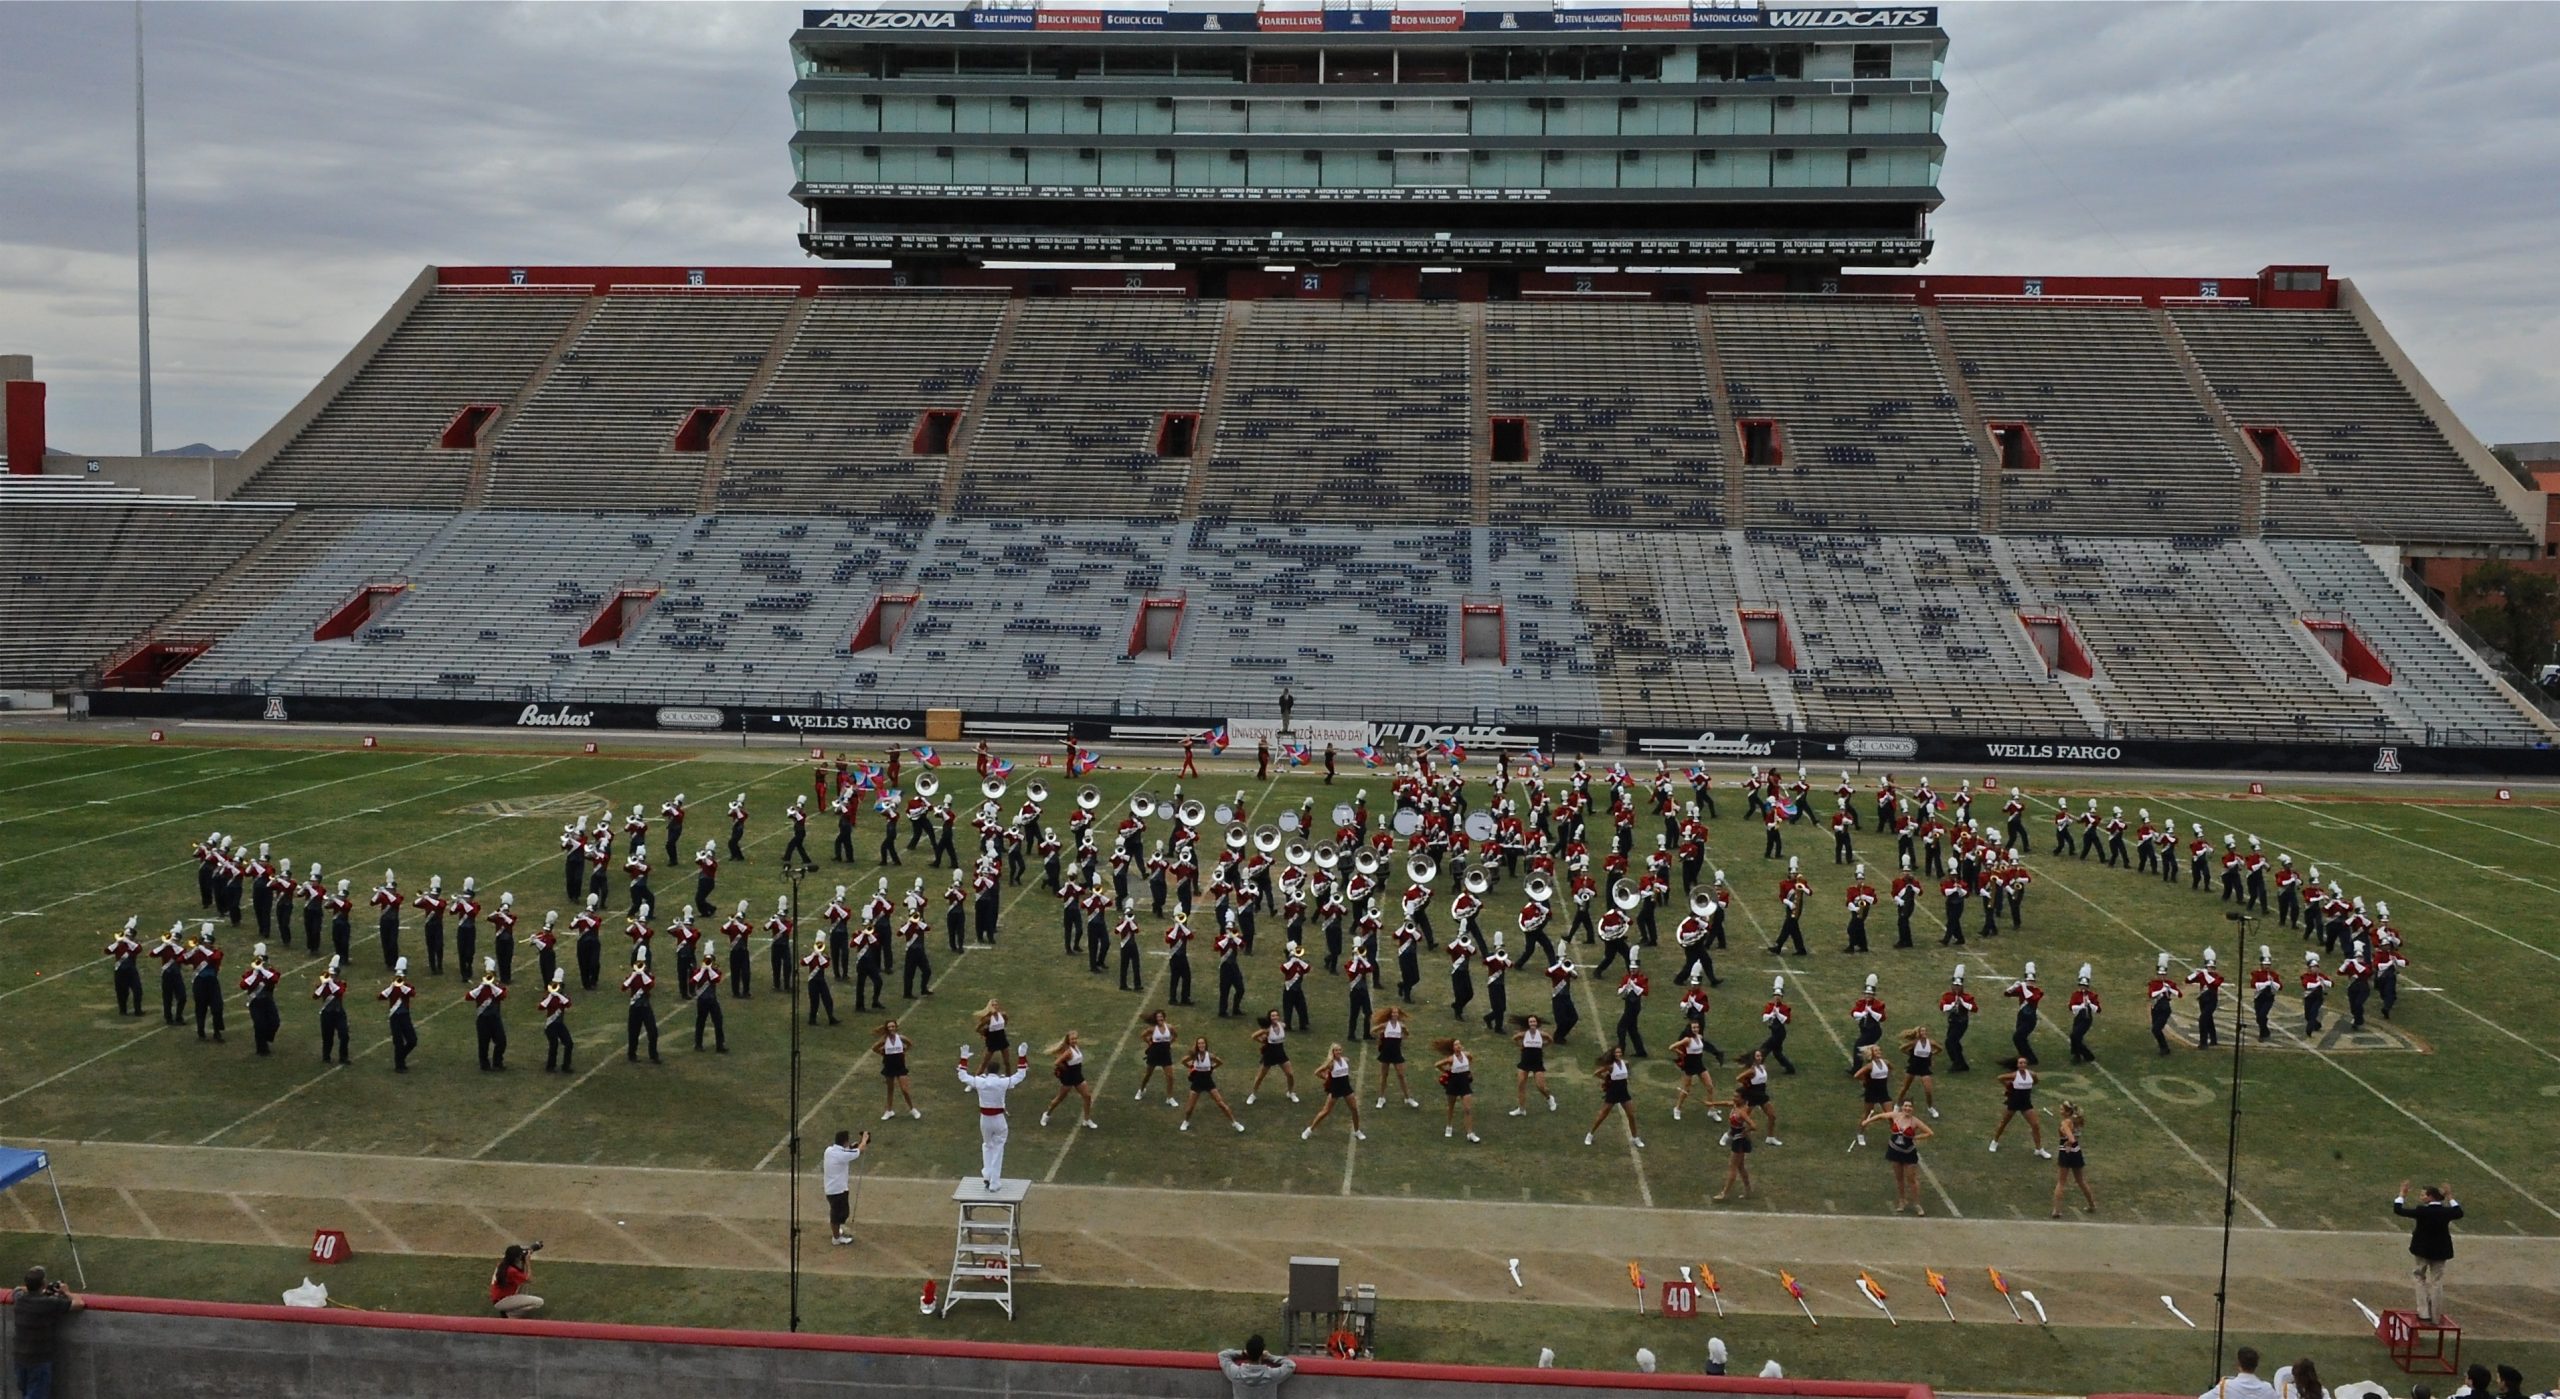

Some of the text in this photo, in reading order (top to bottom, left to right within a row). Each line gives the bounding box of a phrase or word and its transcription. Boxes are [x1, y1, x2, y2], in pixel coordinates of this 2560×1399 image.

[819, 13, 955, 28] ARIZONA
[974, 13, 1032, 23] 22 ART LUPPINO
[1038, 14, 1101, 24] 89 RICKY HUNLEY
[1107, 15, 1163, 24] 6 CHUCK CECIL
[1204, 14, 1221, 30] A
[1258, 16, 1322, 25] 4 DARRYLL LEWIS
[1401, 16, 1418, 24] ROB
[1419, 16, 1456, 24] WALDROP
[1500, 13, 1518, 29] A
[1554, 14, 1622, 23] 28 STEVE McLAUGHLIN
[1630, 14, 1652, 22] CHRIS
[1653, 13, 1690, 22] McALISTER
[1693, 12, 1758, 22] 5 ANTOINE CASON
[1769, 10, 1929, 26] WILDCATS
[512, 275, 524, 284] 17
[689, 275, 703, 285] 18
[894, 276, 906, 286] 19
[1126, 277, 1142, 288] 20
[1305, 279, 1318, 289] 21
[1576, 281, 1592, 292] 22
[1822, 283, 1837, 293] 23
[2025, 286, 2041, 296] 24
[2201, 287, 2217, 297] 25
[88, 461, 100, 471] 16
[264, 697, 287, 720] A
[517, 704, 594, 726] Bashas'
[681, 712, 717, 721] CASINOS
[787, 715, 911, 729] WELLS FARGO
[1231, 728, 1272, 739] UNIVERSITY
[1324, 729, 1345, 741] BAND
[1348, 730, 1364, 742] DAY
[1871, 742, 1911, 751] CASINOS
[1987, 744, 2121, 759] WELLS FARGO
[2374, 747, 2401, 772] A
[314, 1234, 336, 1259] 40
[1667, 1287, 1690, 1312] 40
